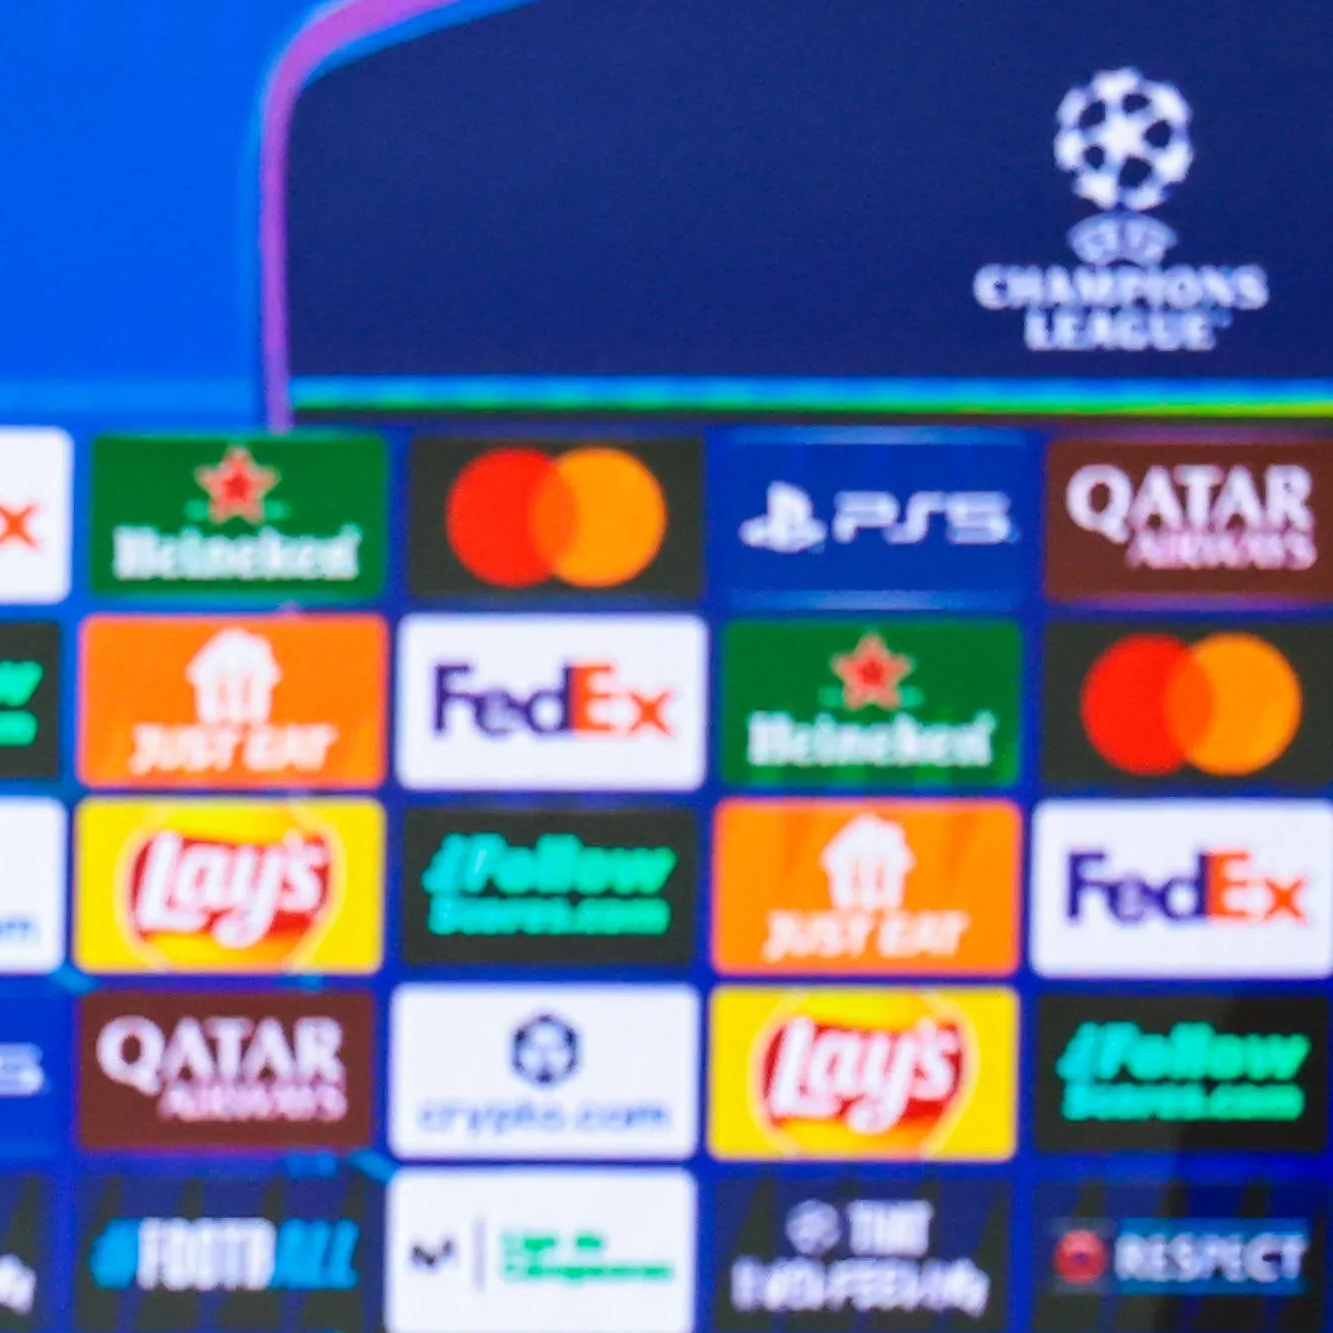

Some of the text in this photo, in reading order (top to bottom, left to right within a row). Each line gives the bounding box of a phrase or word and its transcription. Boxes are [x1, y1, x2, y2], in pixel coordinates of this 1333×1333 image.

[973, 263, 1269, 309] CHAMPIONS
[1024, 307, 1216, 351] LEAGUE
[835, 491, 1013, 545] PS5
[1067, 464, 1313, 543] QATAR
[113, 524, 361, 580] Heineken
[433, 661, 675, 739] FedEx
[130, 724, 339, 775] JUST EAT
[136, 827, 328, 950] Lay's
[1067, 850, 1309, 925] FedEx
[761, 910, 971, 961] JUST EAT
[96, 1016, 343, 1094] QATAR
[767, 1014, 960, 1134] Lay's
[1113, 1230, 1310, 1283] RESPECT
